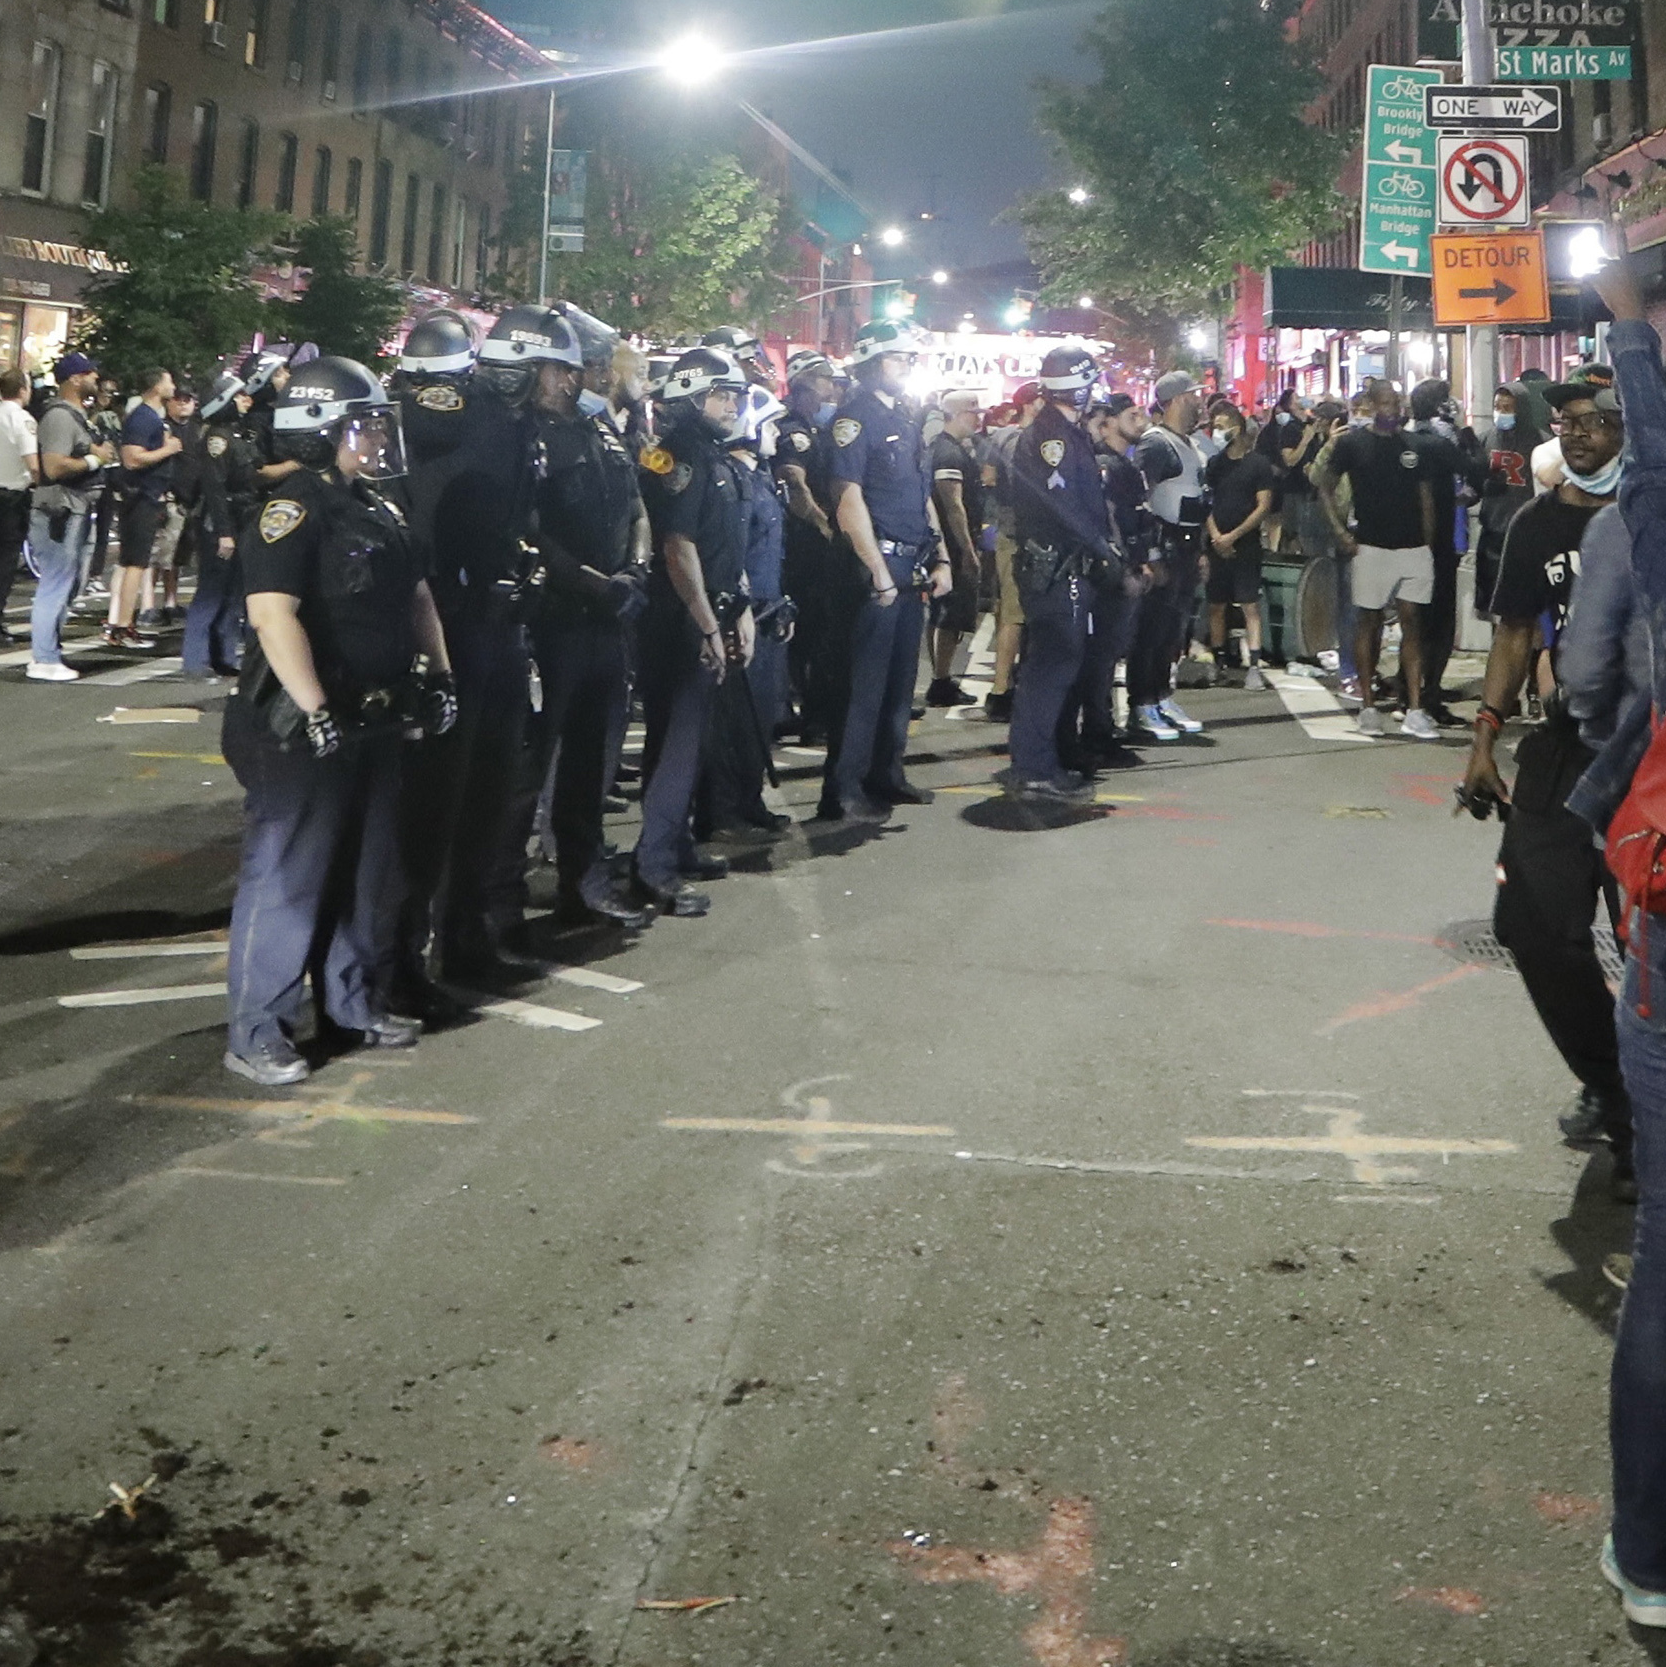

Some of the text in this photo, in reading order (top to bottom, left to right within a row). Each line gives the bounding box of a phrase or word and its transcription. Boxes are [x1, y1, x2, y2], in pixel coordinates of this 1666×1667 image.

[1500, 48, 1627, 75] St Marks Av
[1377, 105, 1424, 122] Brookly
[1436, 99, 1545, 117] ONE WAY
[1383, 122, 1424, 139] Bridge
[1369, 202, 1433, 219] Manhattan
[1380, 220, 1421, 236] Bridge
[1444, 246, 1531, 269] DETOUR
